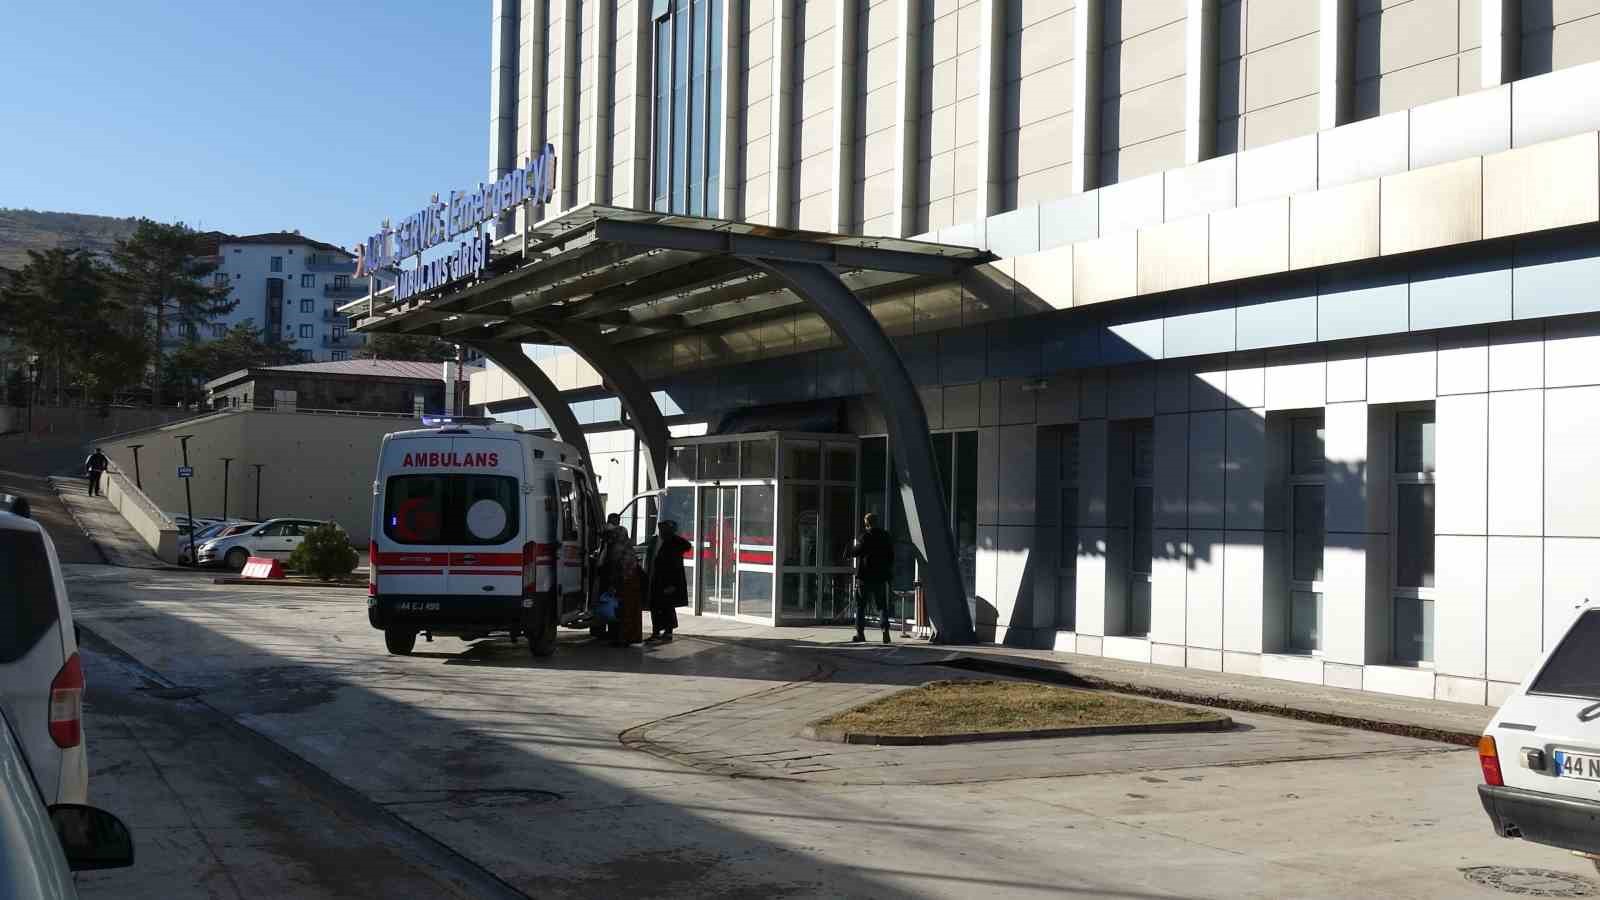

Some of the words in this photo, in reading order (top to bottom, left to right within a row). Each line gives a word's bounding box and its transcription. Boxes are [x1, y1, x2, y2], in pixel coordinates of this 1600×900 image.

[393, 257, 448, 303] AMBULANS
[403, 452, 498, 468] AMBULANS
[1564, 756, 1583, 776] 44
